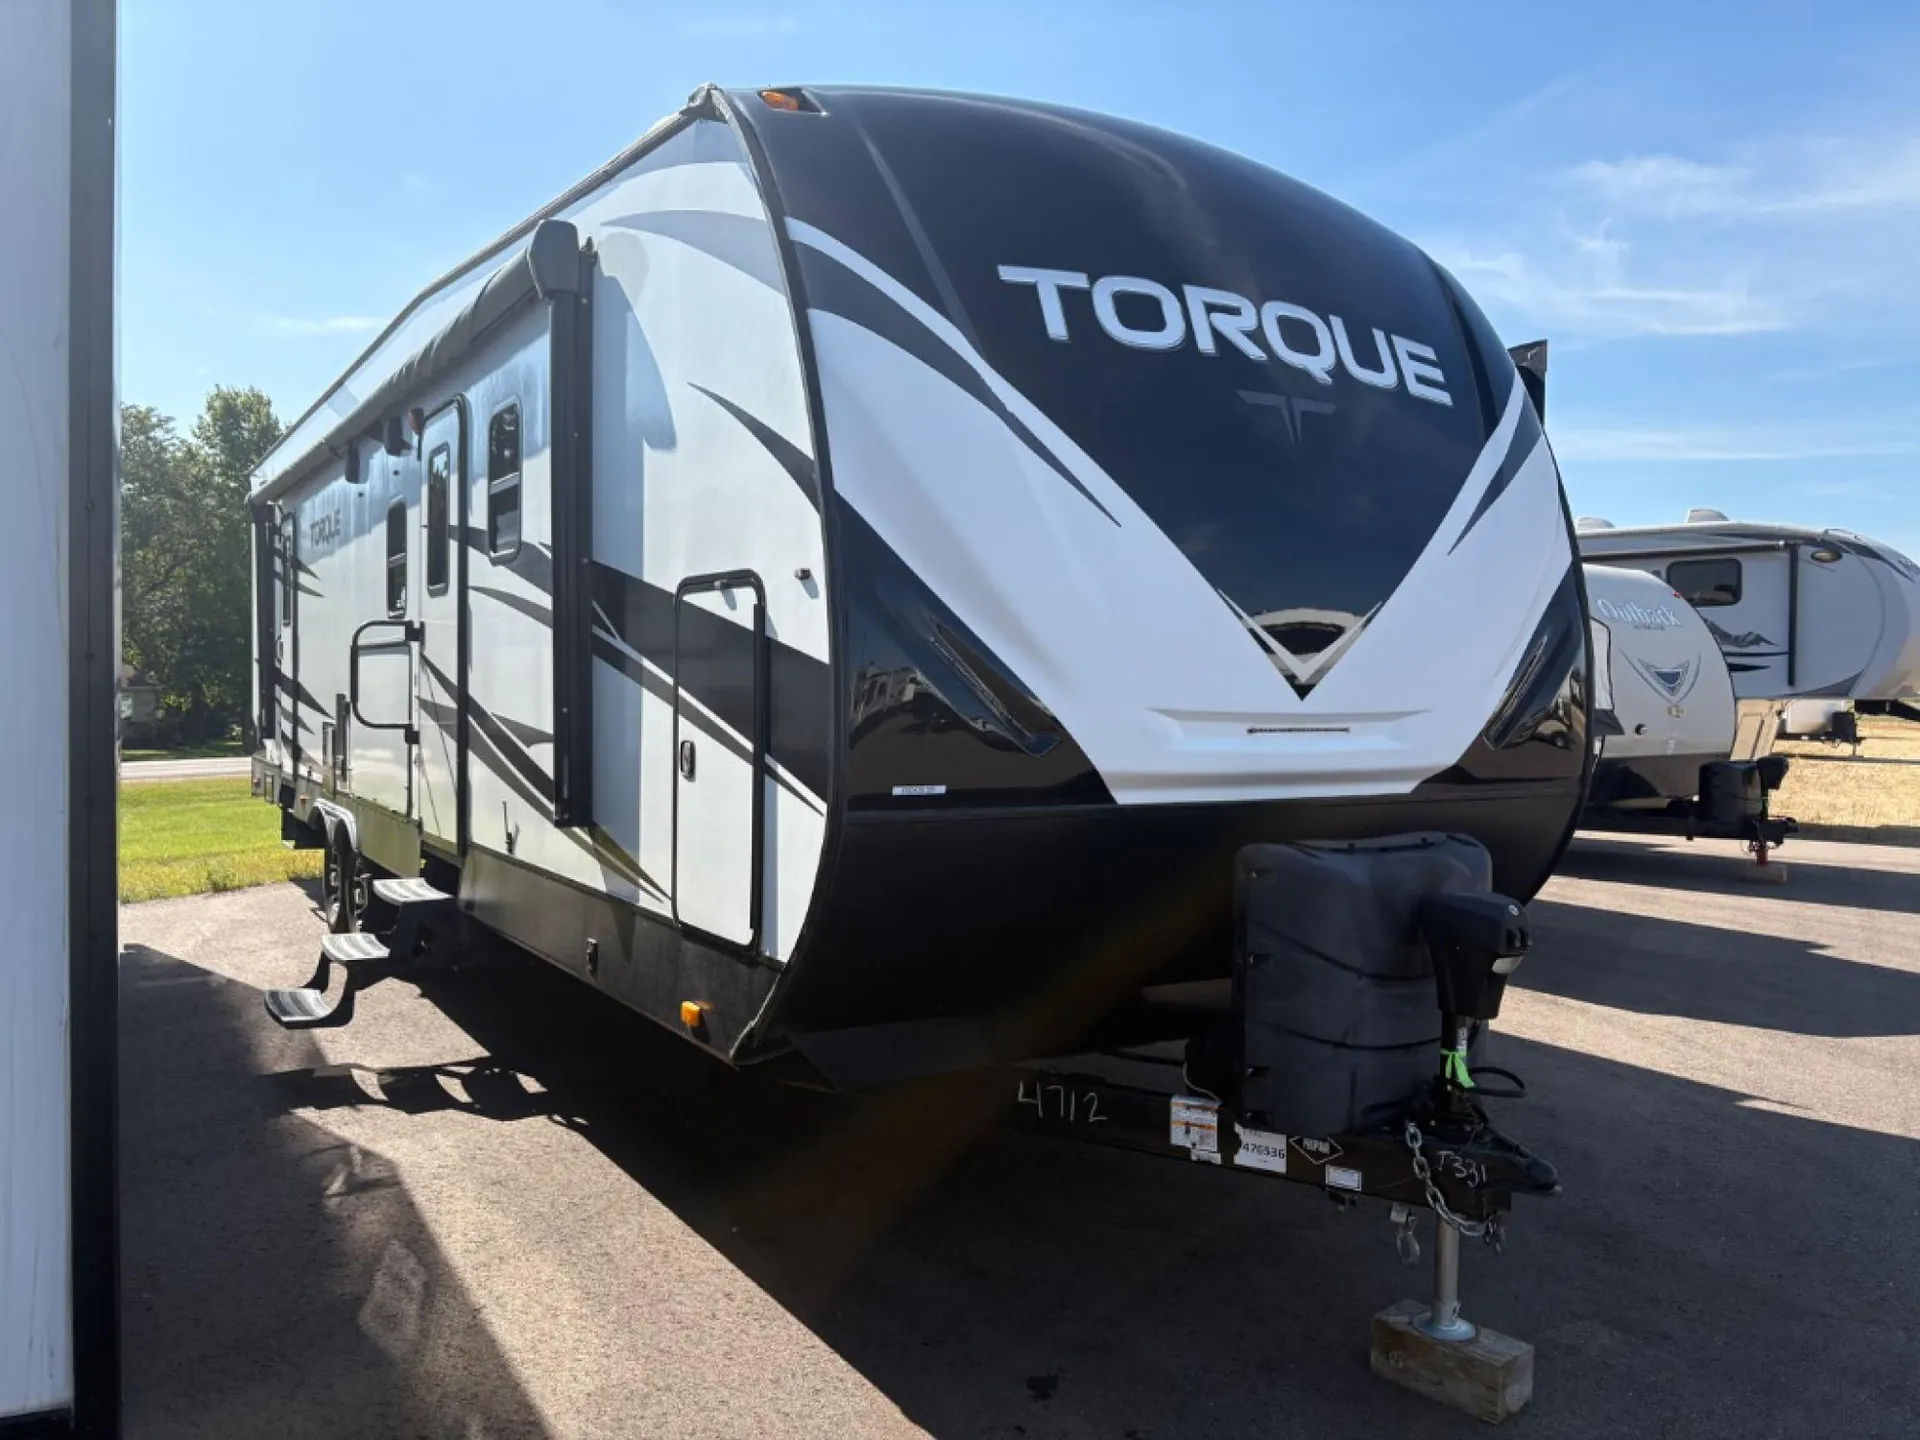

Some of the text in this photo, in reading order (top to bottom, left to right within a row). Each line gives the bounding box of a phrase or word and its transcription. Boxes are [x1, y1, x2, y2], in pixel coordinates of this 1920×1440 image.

[996, 264, 1454, 407] TORQUE
[310, 509, 341, 549] TORQUE
[1596, 598, 1682, 627] Outback
[1017, 1079, 1107, 1123] 4712
